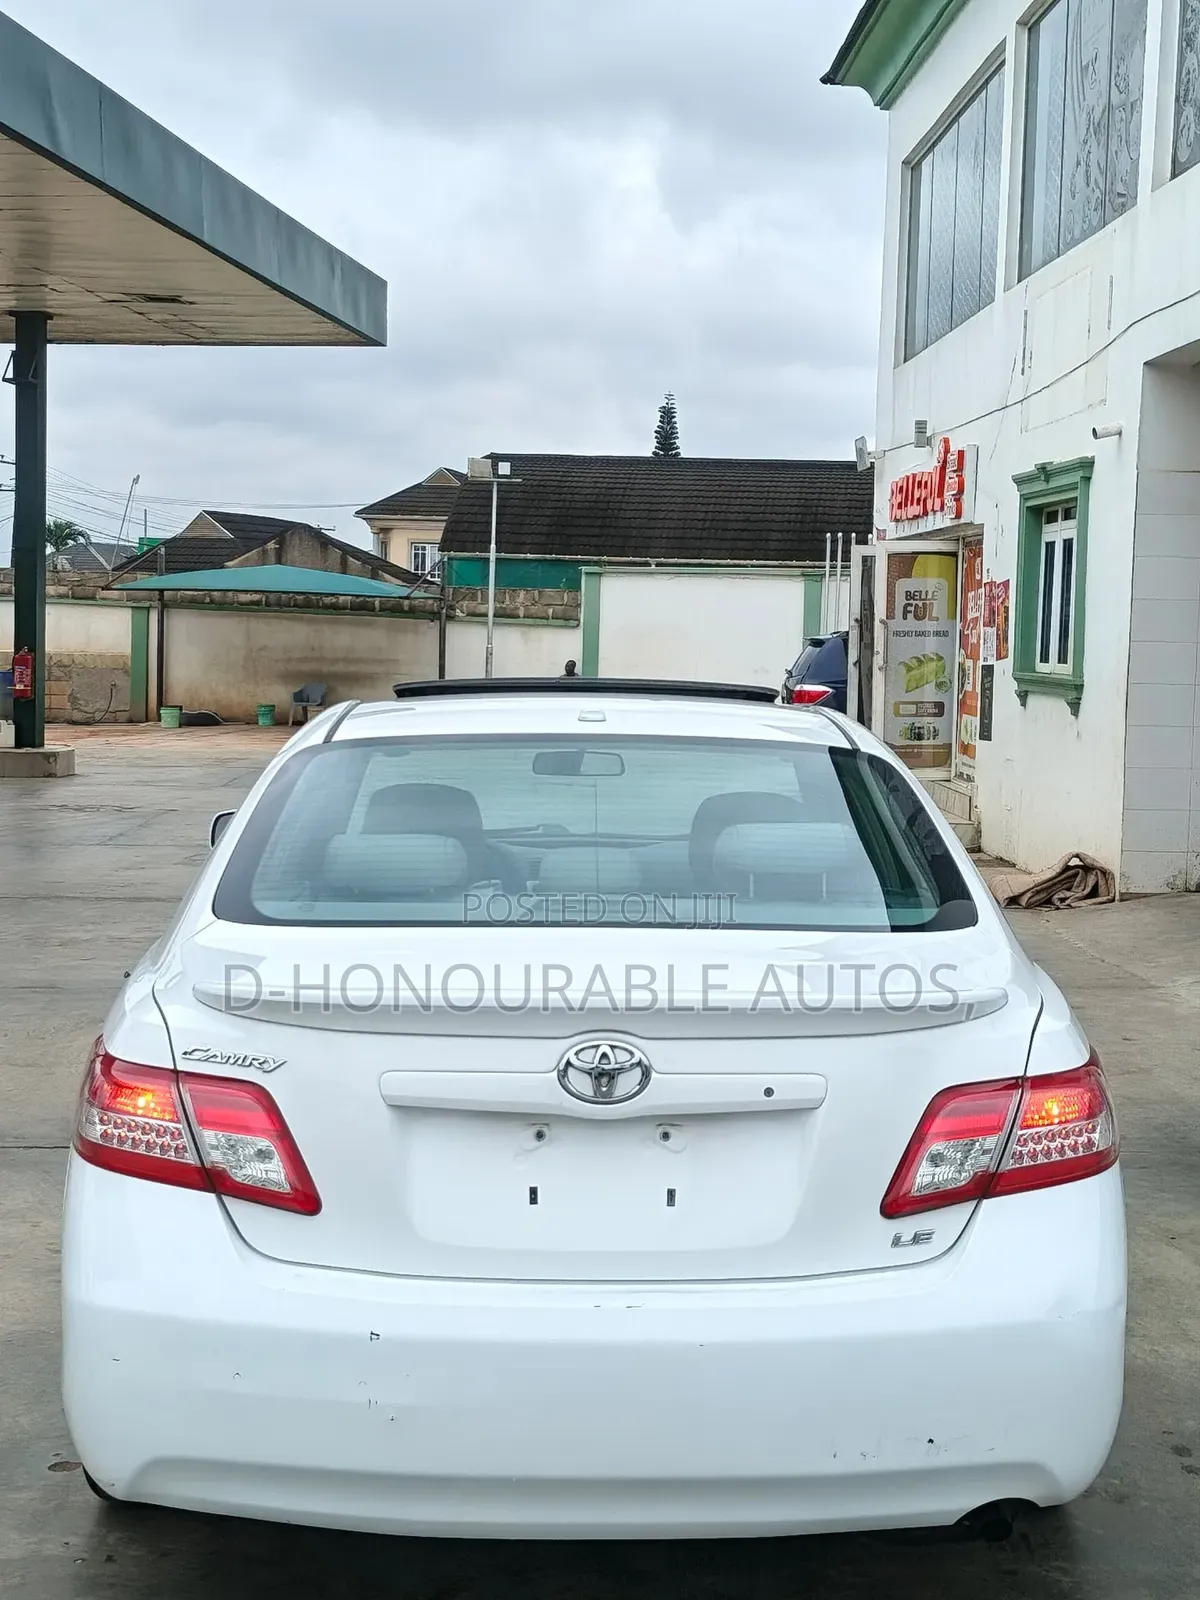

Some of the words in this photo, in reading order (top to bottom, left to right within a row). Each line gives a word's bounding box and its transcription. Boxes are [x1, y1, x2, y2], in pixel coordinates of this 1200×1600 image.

[904, 589, 940, 602] BELLE
[902, 602, 940, 622] FUL
[892, 629, 914, 638] FRESHLY
[914, 629, 932, 638] BAKED
[932, 629, 950, 638] BREAD
[180, 1046, 288, 1074] CAMRY
[891, 1228, 936, 1248] LE
